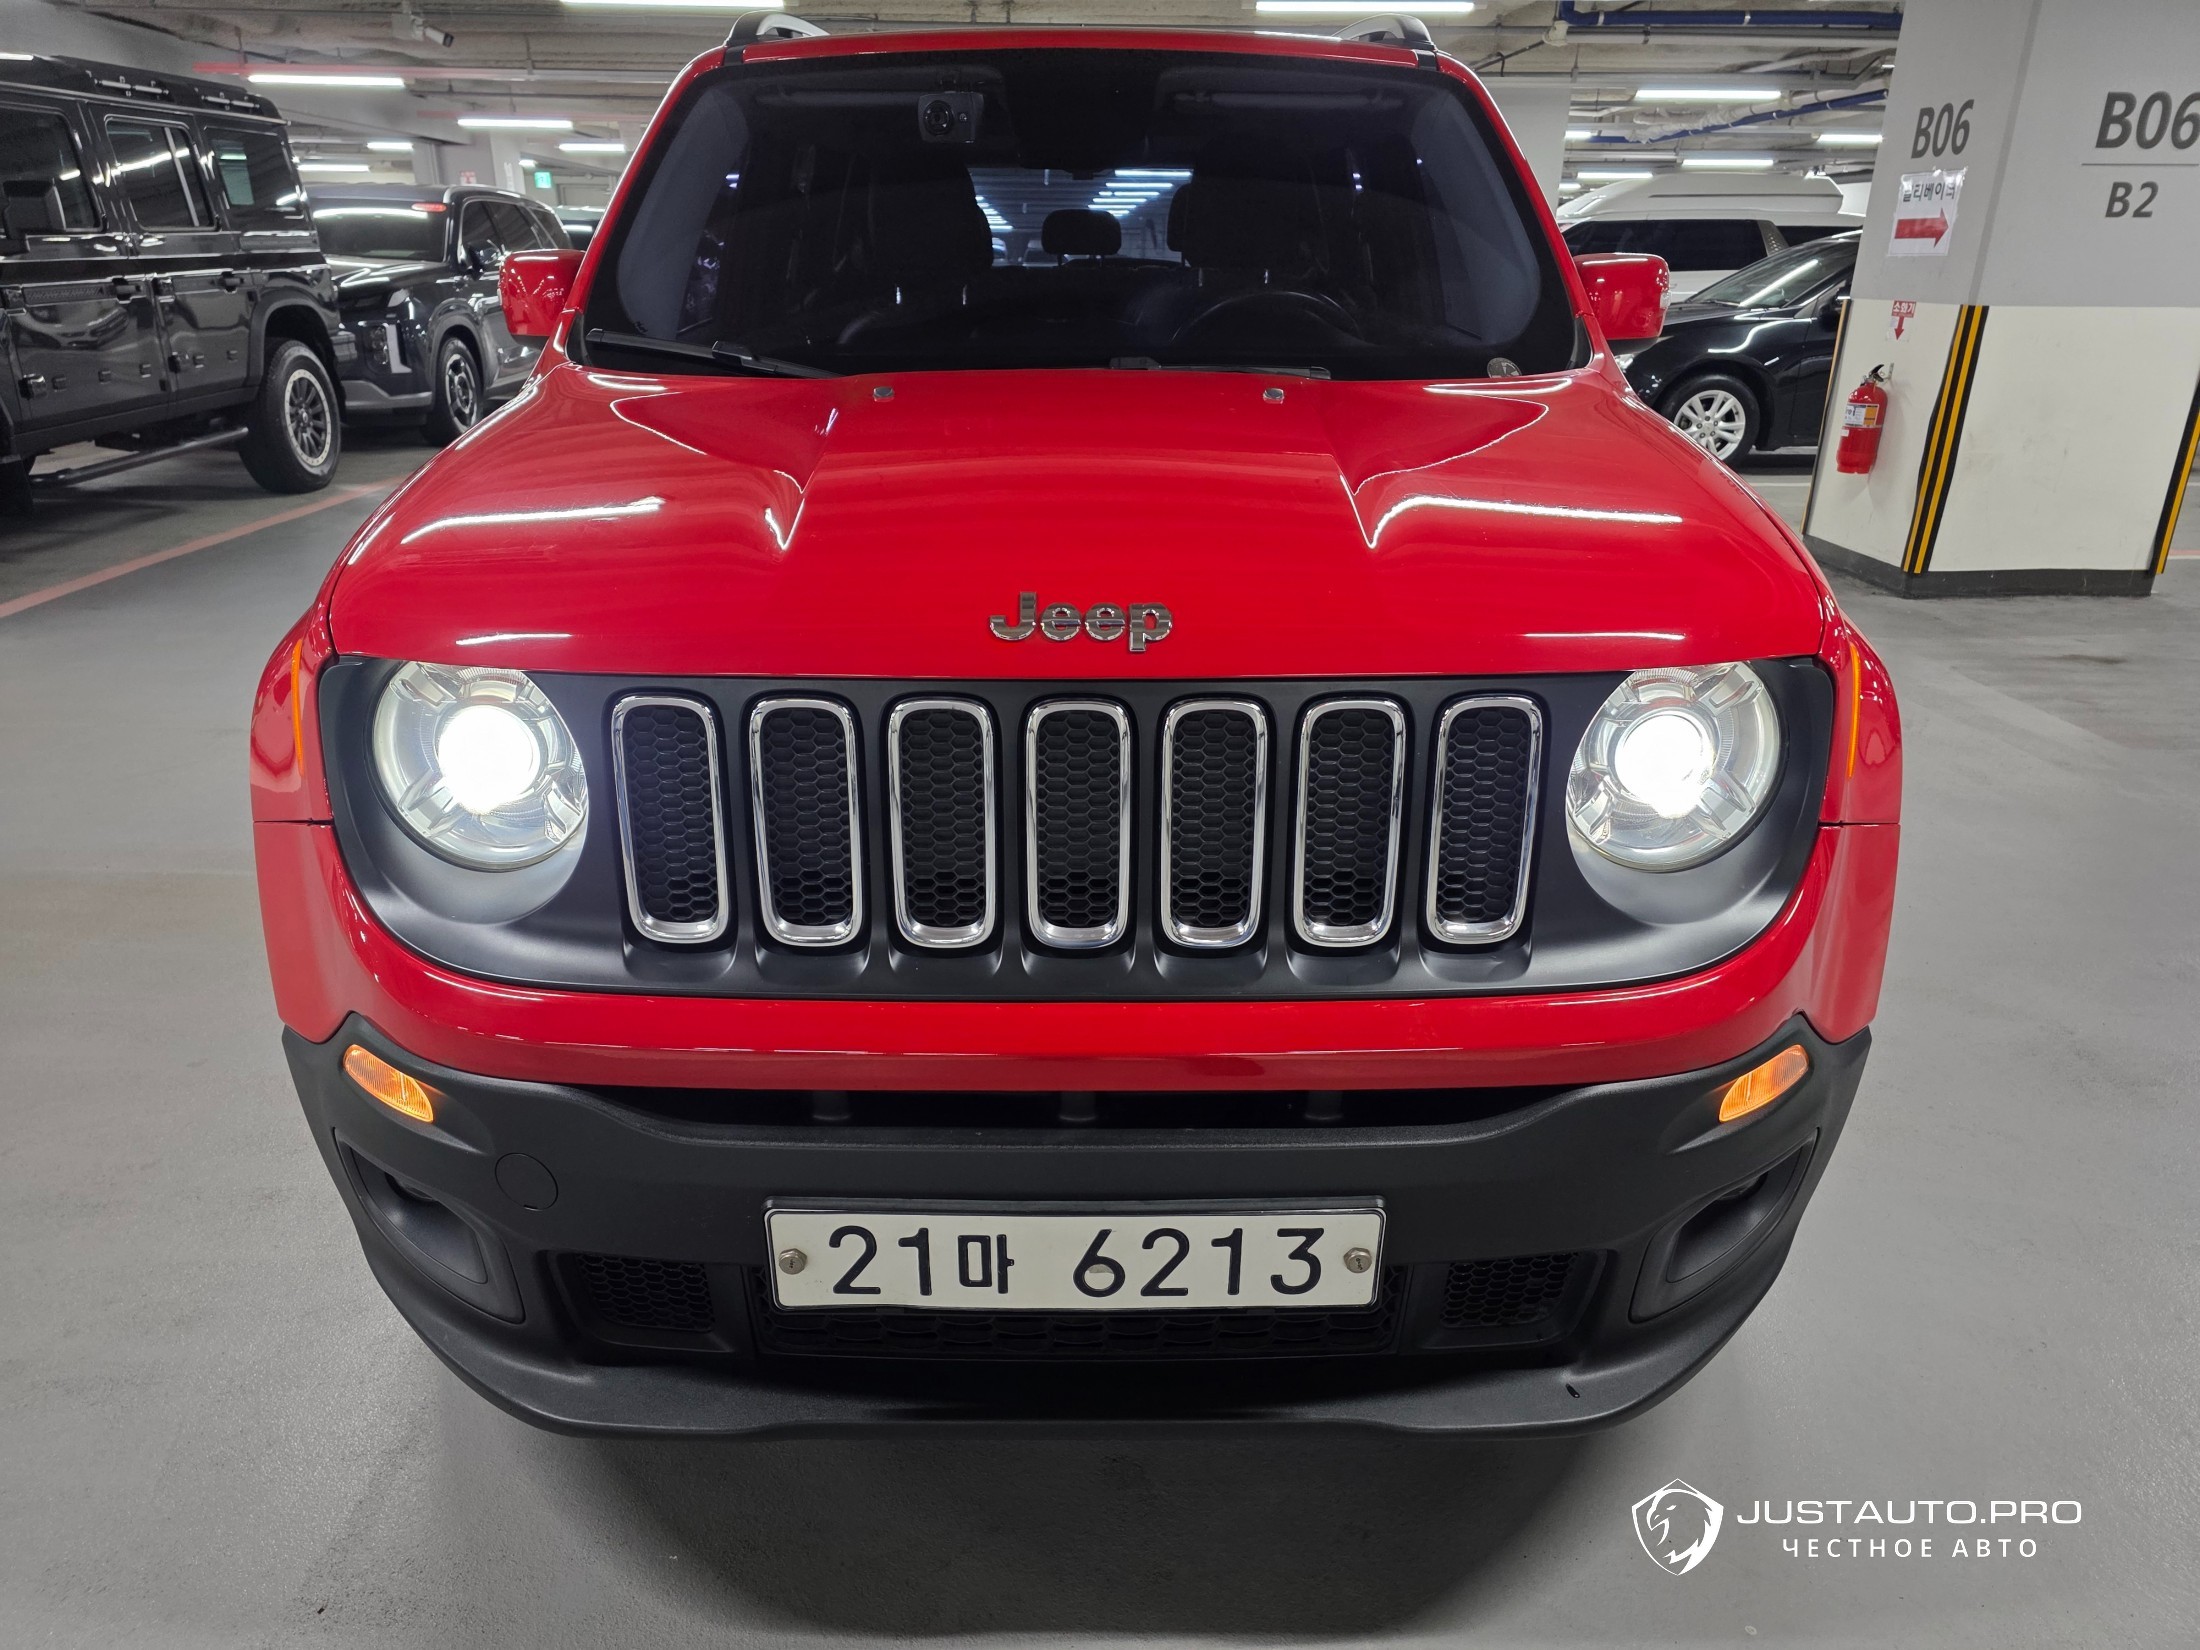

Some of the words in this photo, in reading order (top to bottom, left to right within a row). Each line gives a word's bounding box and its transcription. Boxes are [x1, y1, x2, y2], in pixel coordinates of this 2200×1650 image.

[1911, 99, 1975, 159] B06
[2095, 91, 2200, 149] B06
[2105, 181, 2159, 218] B2
[990, 591, 1172, 652] Jeep
[828, 1224, 1015, 1297] 21마
[1072, 1226, 1326, 1298] 6213
